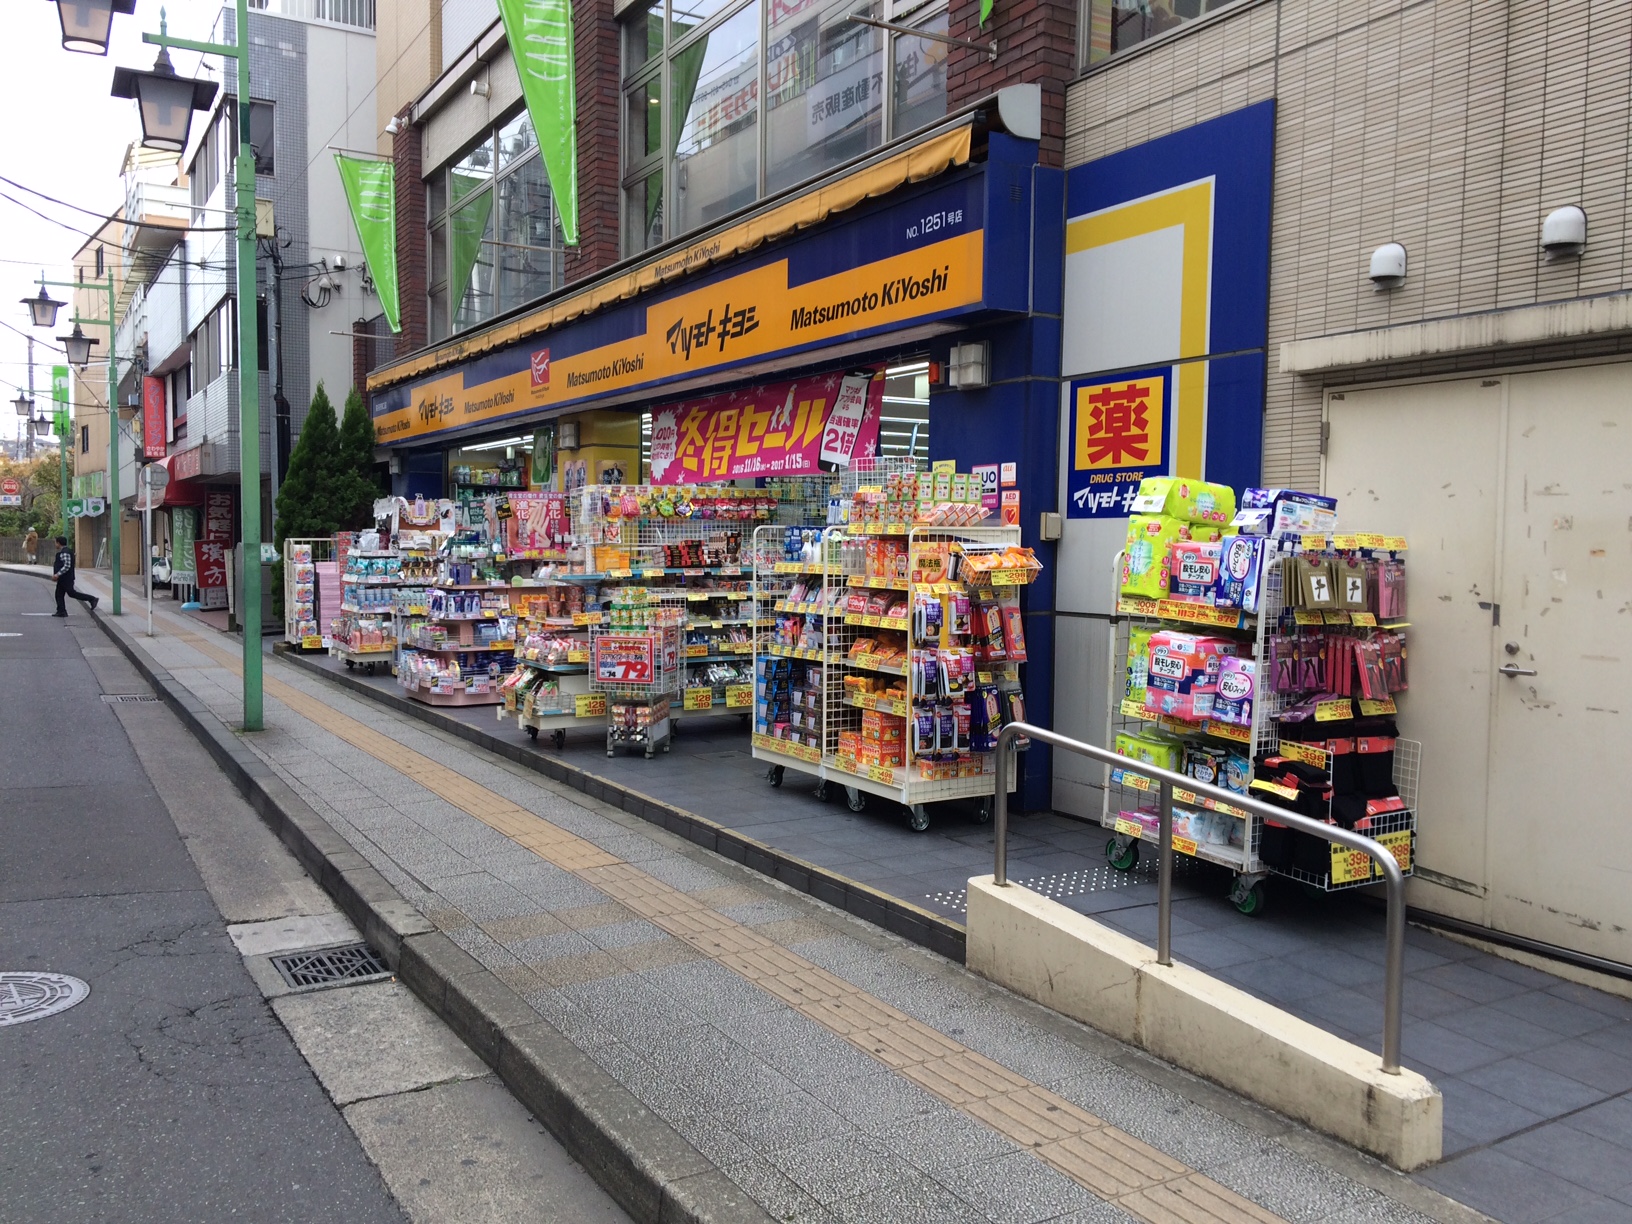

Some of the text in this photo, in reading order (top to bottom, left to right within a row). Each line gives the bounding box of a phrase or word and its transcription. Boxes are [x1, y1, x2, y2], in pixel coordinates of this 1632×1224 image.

[654, 240, 721, 278] Matsumoto KiYoshi
[790, 265, 950, 331] Matsumoto KiYoshi
[666, 303, 760, 361] マツモトキヨシ
[566, 353, 645, 389] Matsumoto KiYoshi
[464, 397, 495, 415] Matsumoto
[494, 388, 515, 407] KiYoshi
[1087, 383, 1150, 465] 薬
[676, 397, 827, 478] 冬得セール
[823, 428, 856, 456] 2倍
[1090, 471, 1144, 484] DRUG STORE
[1004, 492, 1017, 501] AED
[1073, 485, 1140, 514] マツモトキ
[516, 500, 530, 519] 進化
[548, 500, 561, 519] 進化
[201, 542, 226, 585] 漢方
[1137, 600, 1157, 609] 1008
[1139, 607, 1155, 615] 934
[1177, 609, 1196, 618] 1113
[1216, 614, 1237, 624] 876
[616, 661, 649, 679] 79
[694, 694, 711, 702] 128
[737, 691, 753, 699] 108
[588, 700, 606, 709] 128
[1333, 704, 1350, 712] 398
[591, 708, 604, 716] 119
[1141, 711, 1157, 720] 934
[1229, 728, 1250, 739] 876
[1302, 751, 1325, 763] 398
[1391, 843, 1410, 858] 398
[1349, 851, 1369, 867] 398
[1351, 865, 1368, 878] 369
